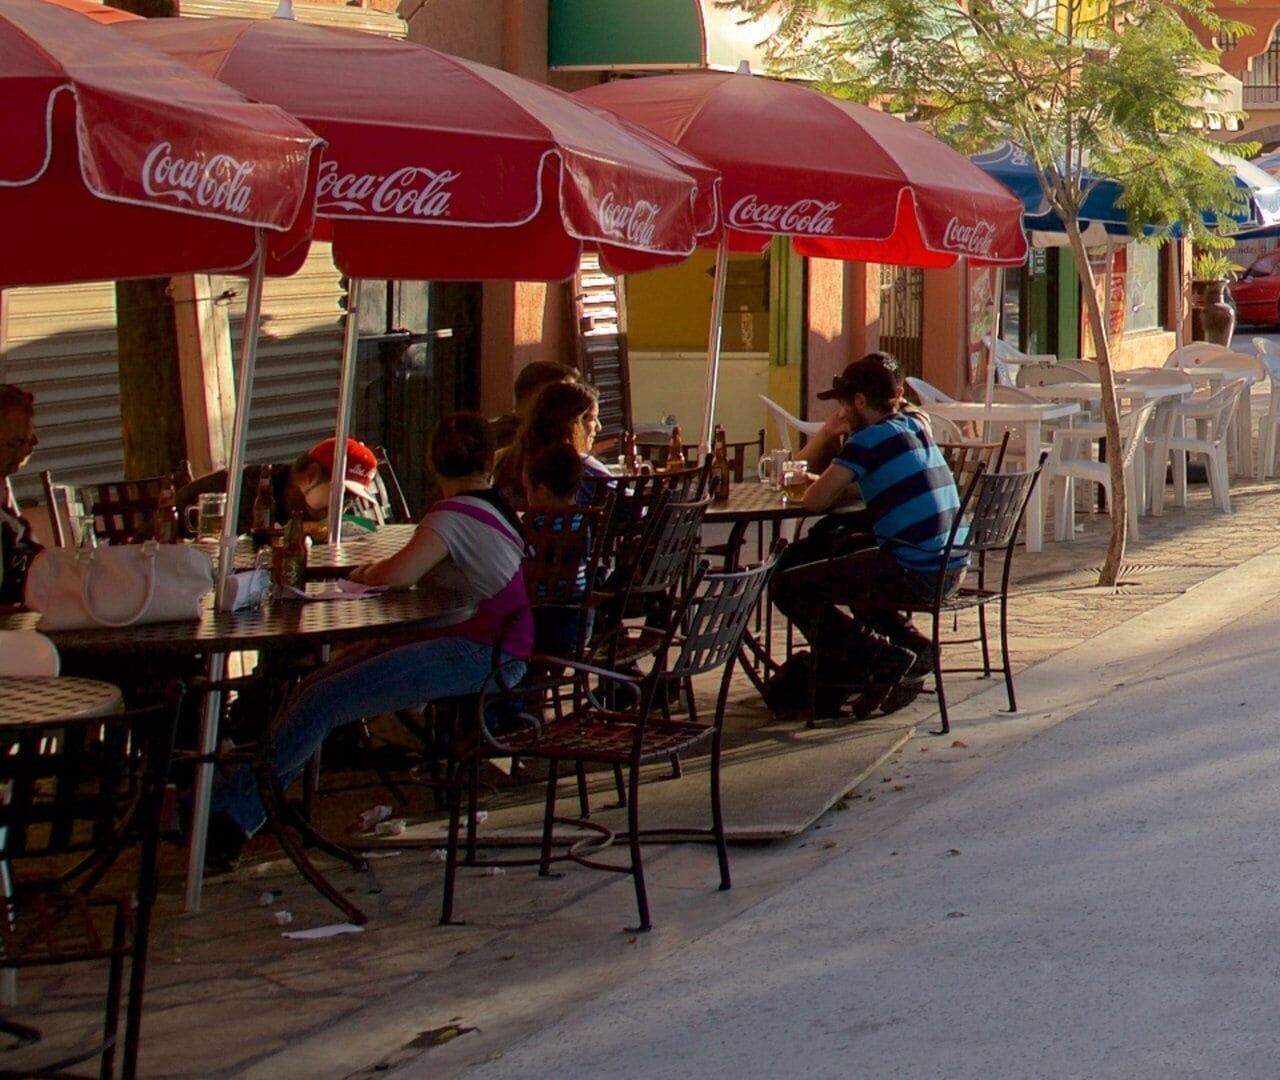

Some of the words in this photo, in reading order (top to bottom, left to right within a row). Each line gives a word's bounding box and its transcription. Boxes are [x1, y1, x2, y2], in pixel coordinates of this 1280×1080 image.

[142, 141, 257, 214] Coca-Cola
[599, 191, 661, 247] Coca-Cola
[728, 194, 842, 234] Coca-Cola
[942, 215, 997, 255] Coca-Cola
